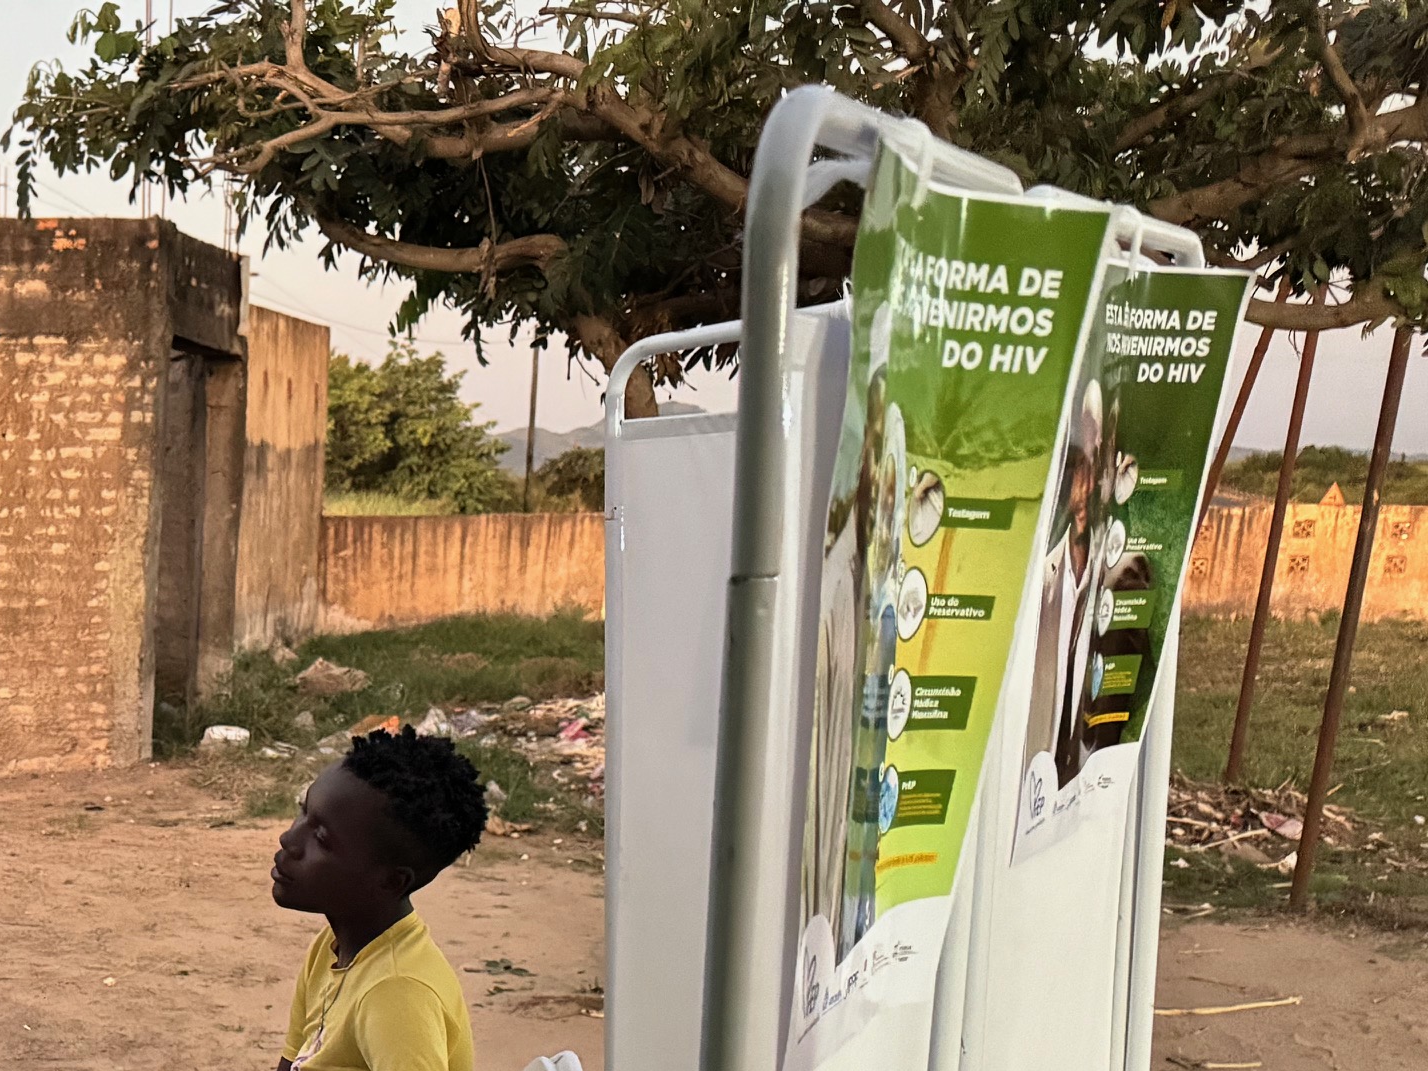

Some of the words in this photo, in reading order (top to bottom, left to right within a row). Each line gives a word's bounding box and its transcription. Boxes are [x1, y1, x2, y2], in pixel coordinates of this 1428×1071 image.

[1018, 267, 1063, 299] DE
[1186, 310, 1218, 331] DE
[942, 339, 983, 370] DO
[989, 343, 1049, 375] HIV
[1137, 362, 1164, 384] DO
[1167, 363, 1206, 384] HIV
[928, 606, 986, 618] Preservativo
[930, 596, 946, 607] Uso
